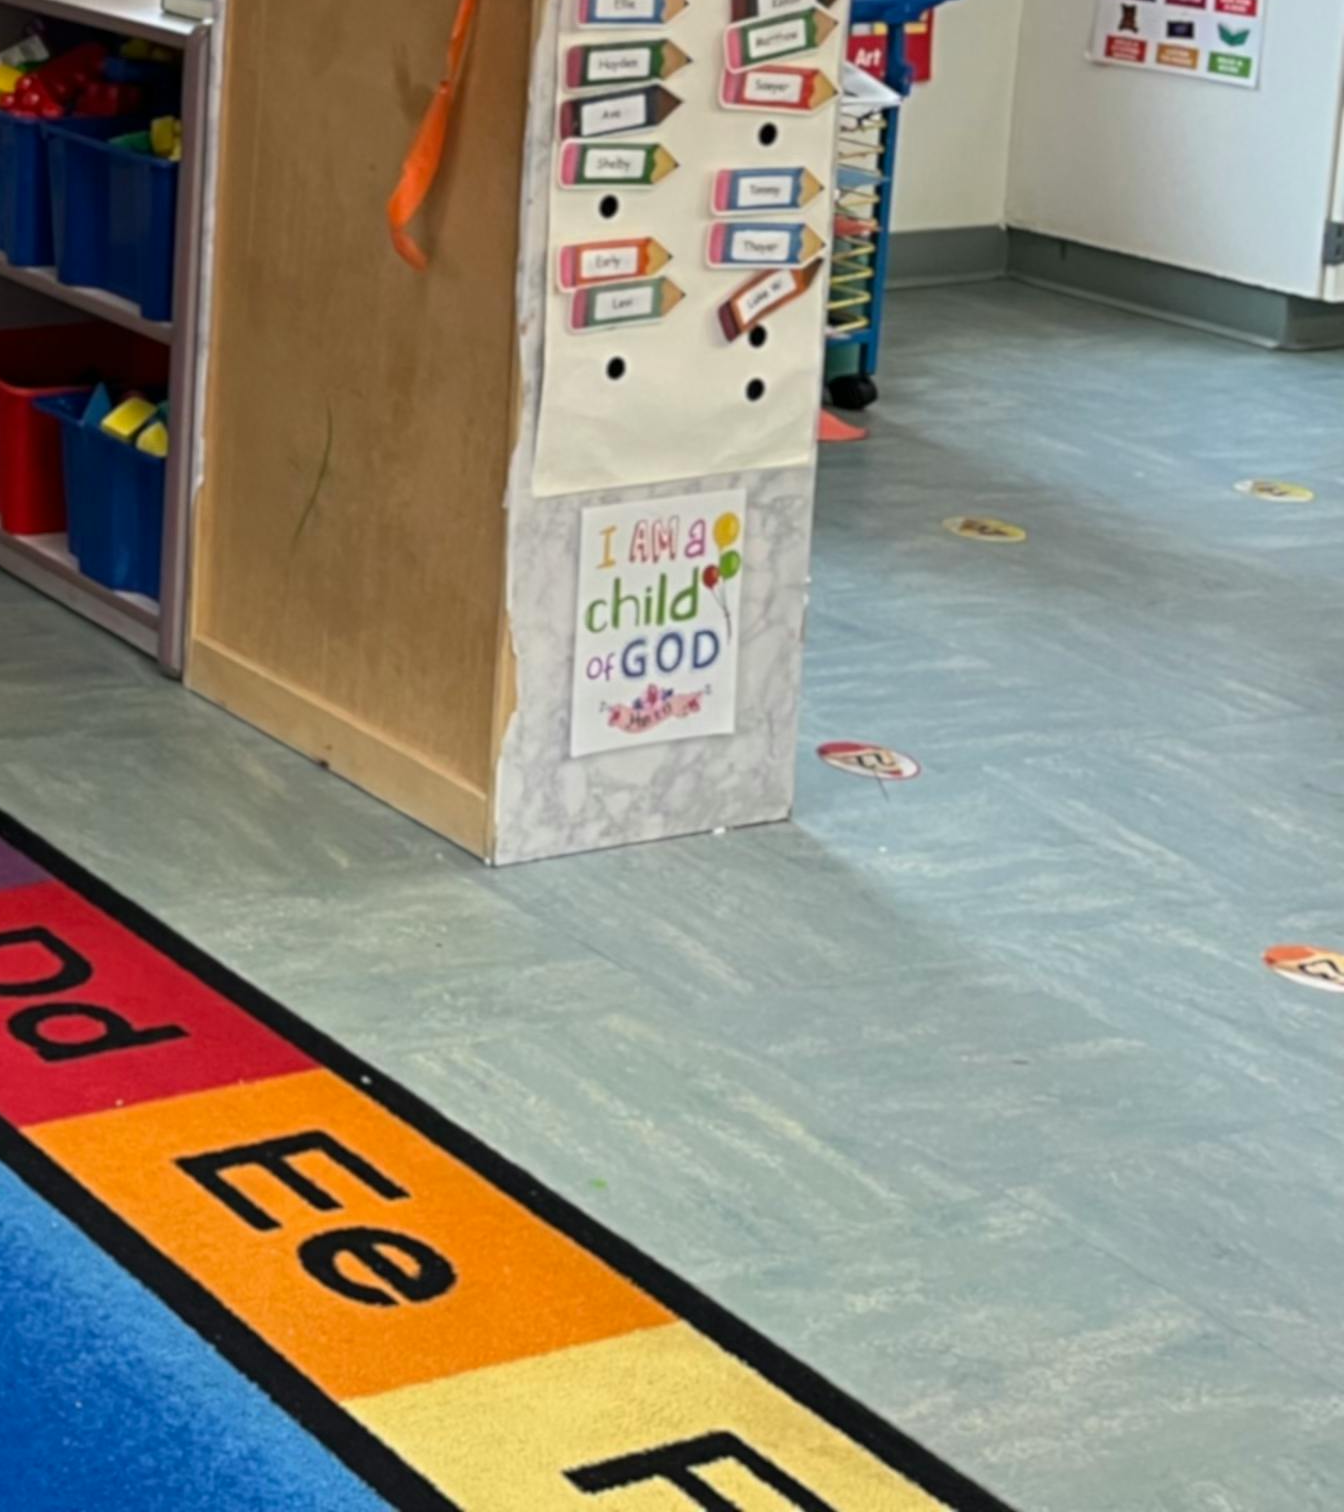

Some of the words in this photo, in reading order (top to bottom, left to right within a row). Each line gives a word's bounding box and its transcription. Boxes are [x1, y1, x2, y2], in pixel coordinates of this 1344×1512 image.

[597, 56, 639, 71] Hayden
[854, 47, 882, 67] Art
[597, 156, 632, 171] Shelby
[595, 524, 618, 571] I
[627, 514, 681, 564] AM
[683, 518, 707, 560] a
[583, 566, 700, 635] child
[584, 651, 616, 683] of
[620, 629, 721, 681] GOD
[175, 1128, 460, 1309] Ee
